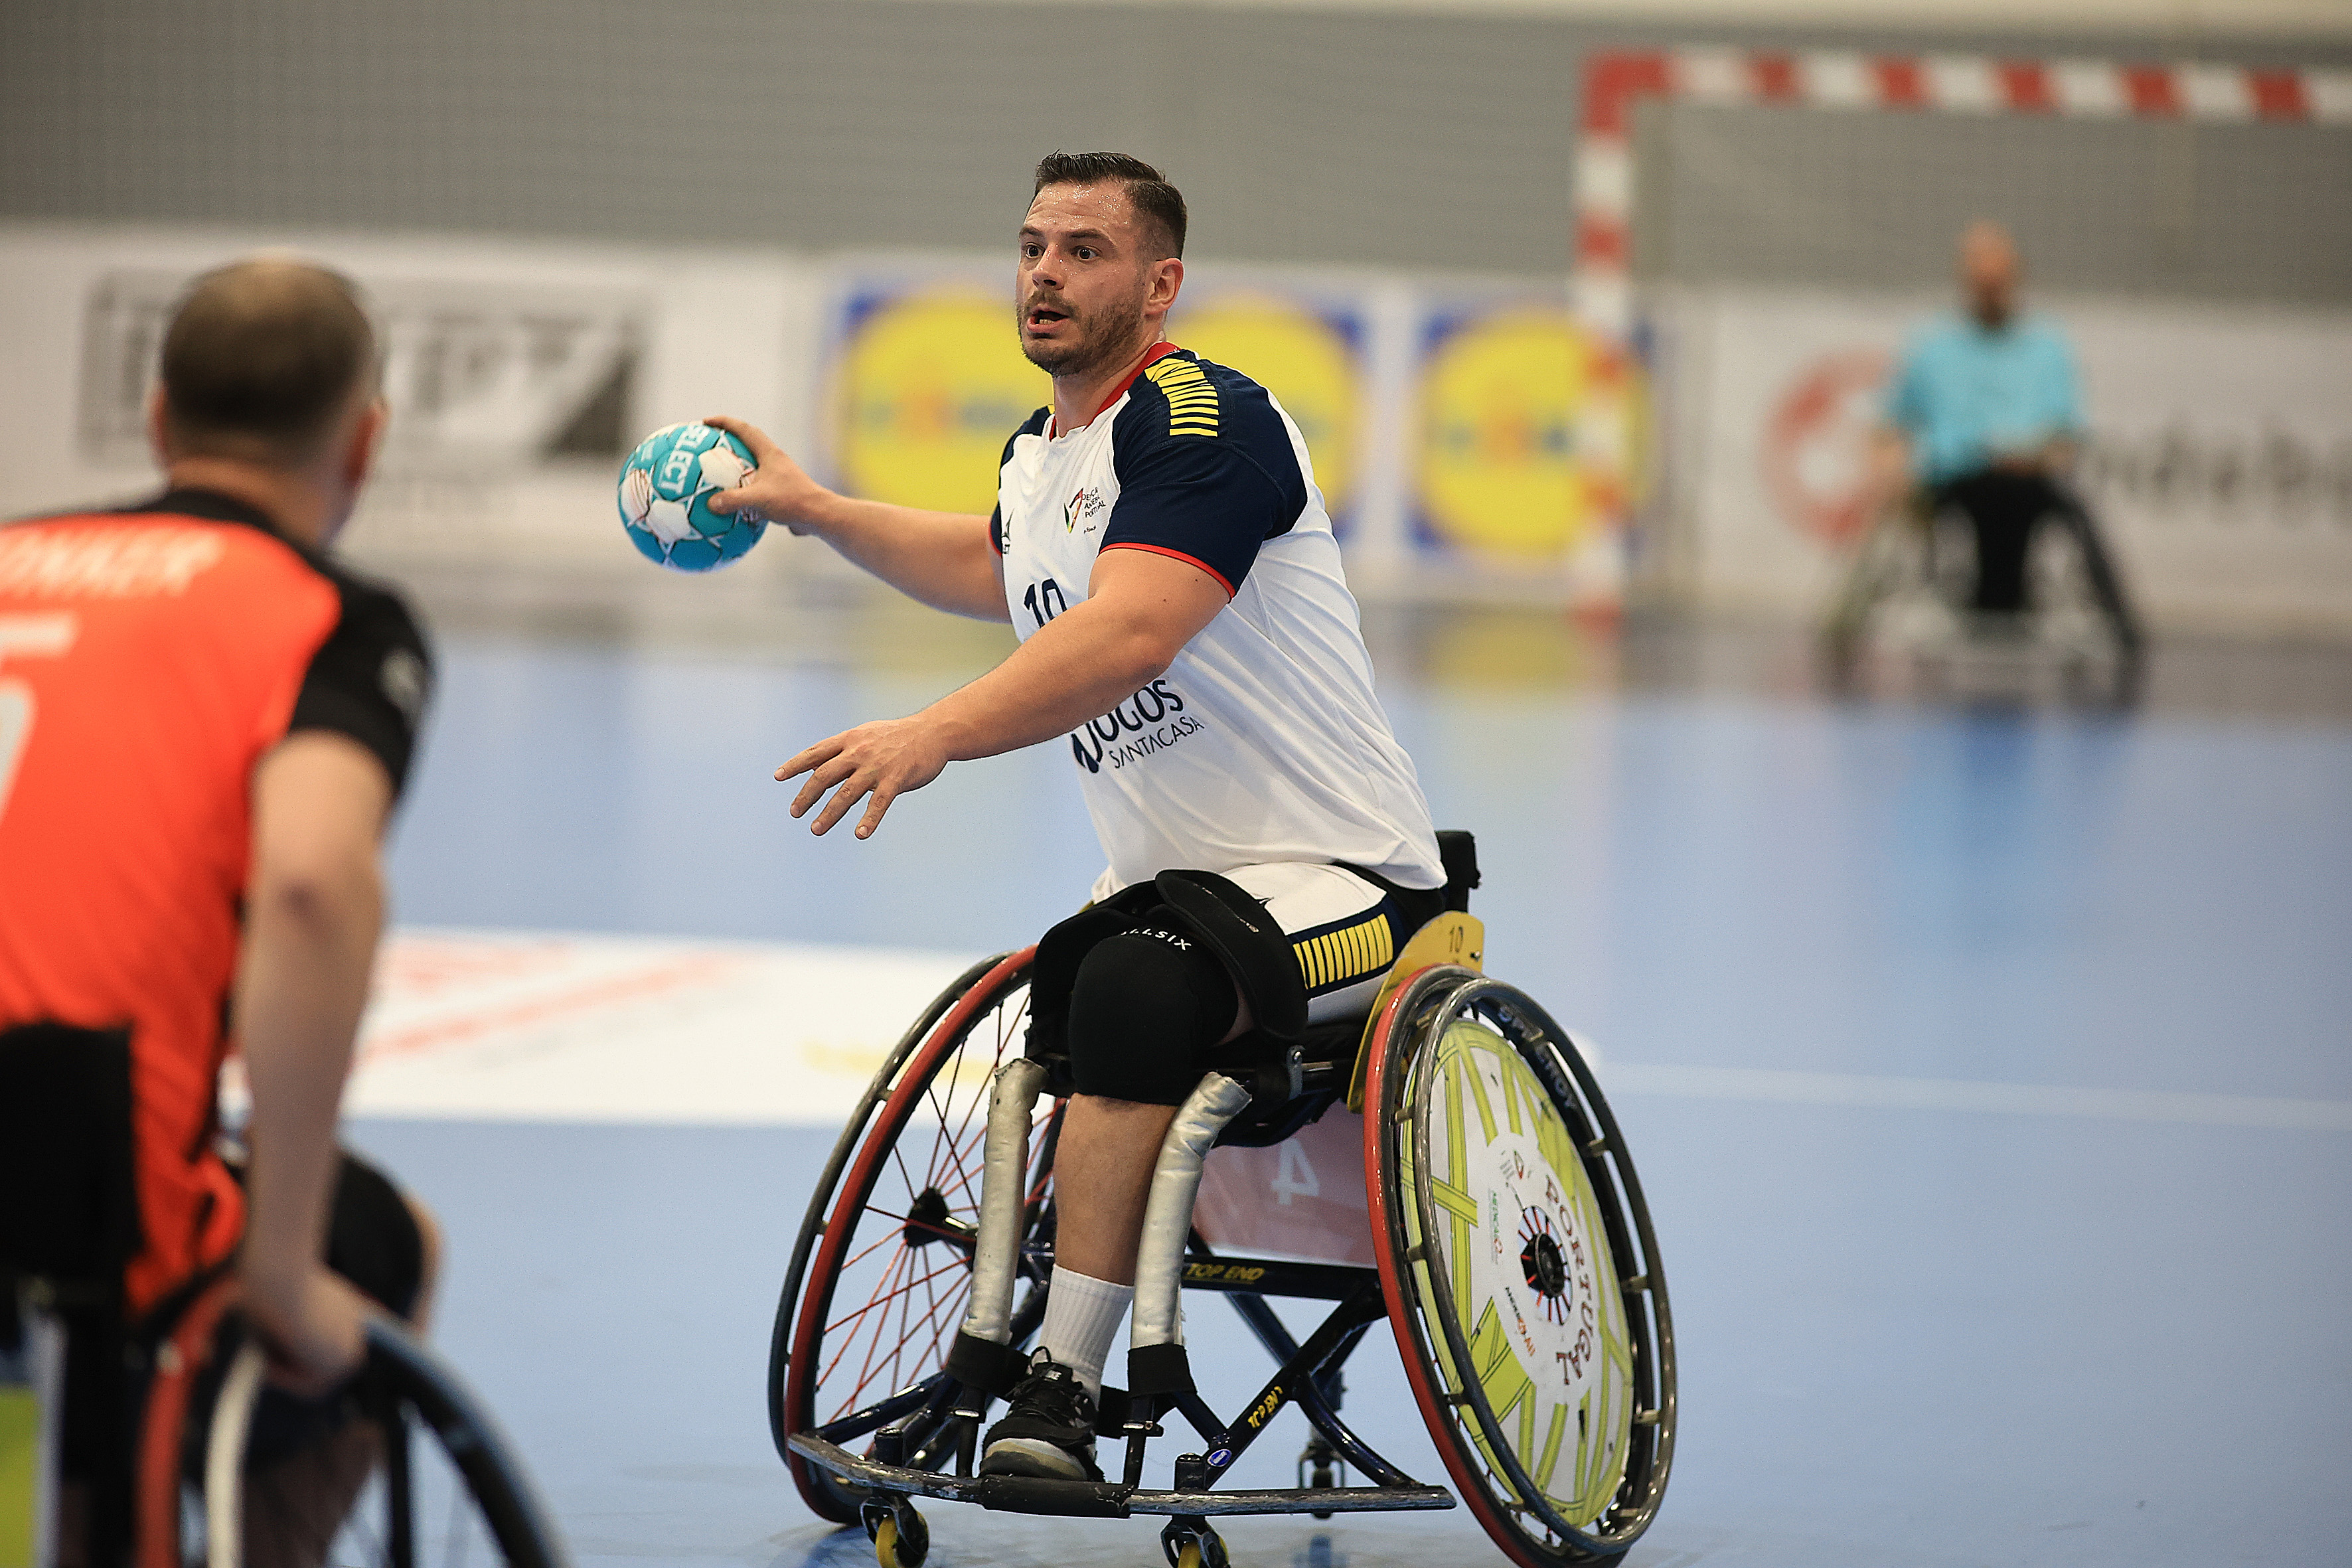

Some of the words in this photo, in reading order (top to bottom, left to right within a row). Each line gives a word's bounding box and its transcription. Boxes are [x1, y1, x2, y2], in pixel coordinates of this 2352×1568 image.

[1024, 578, 1067, 629] 10
[1109, 716, 1206, 769] SANTACASA
[1121, 928, 1192, 951] LLSIX
[1545, 1174, 1594, 1385] PORTUGAL
